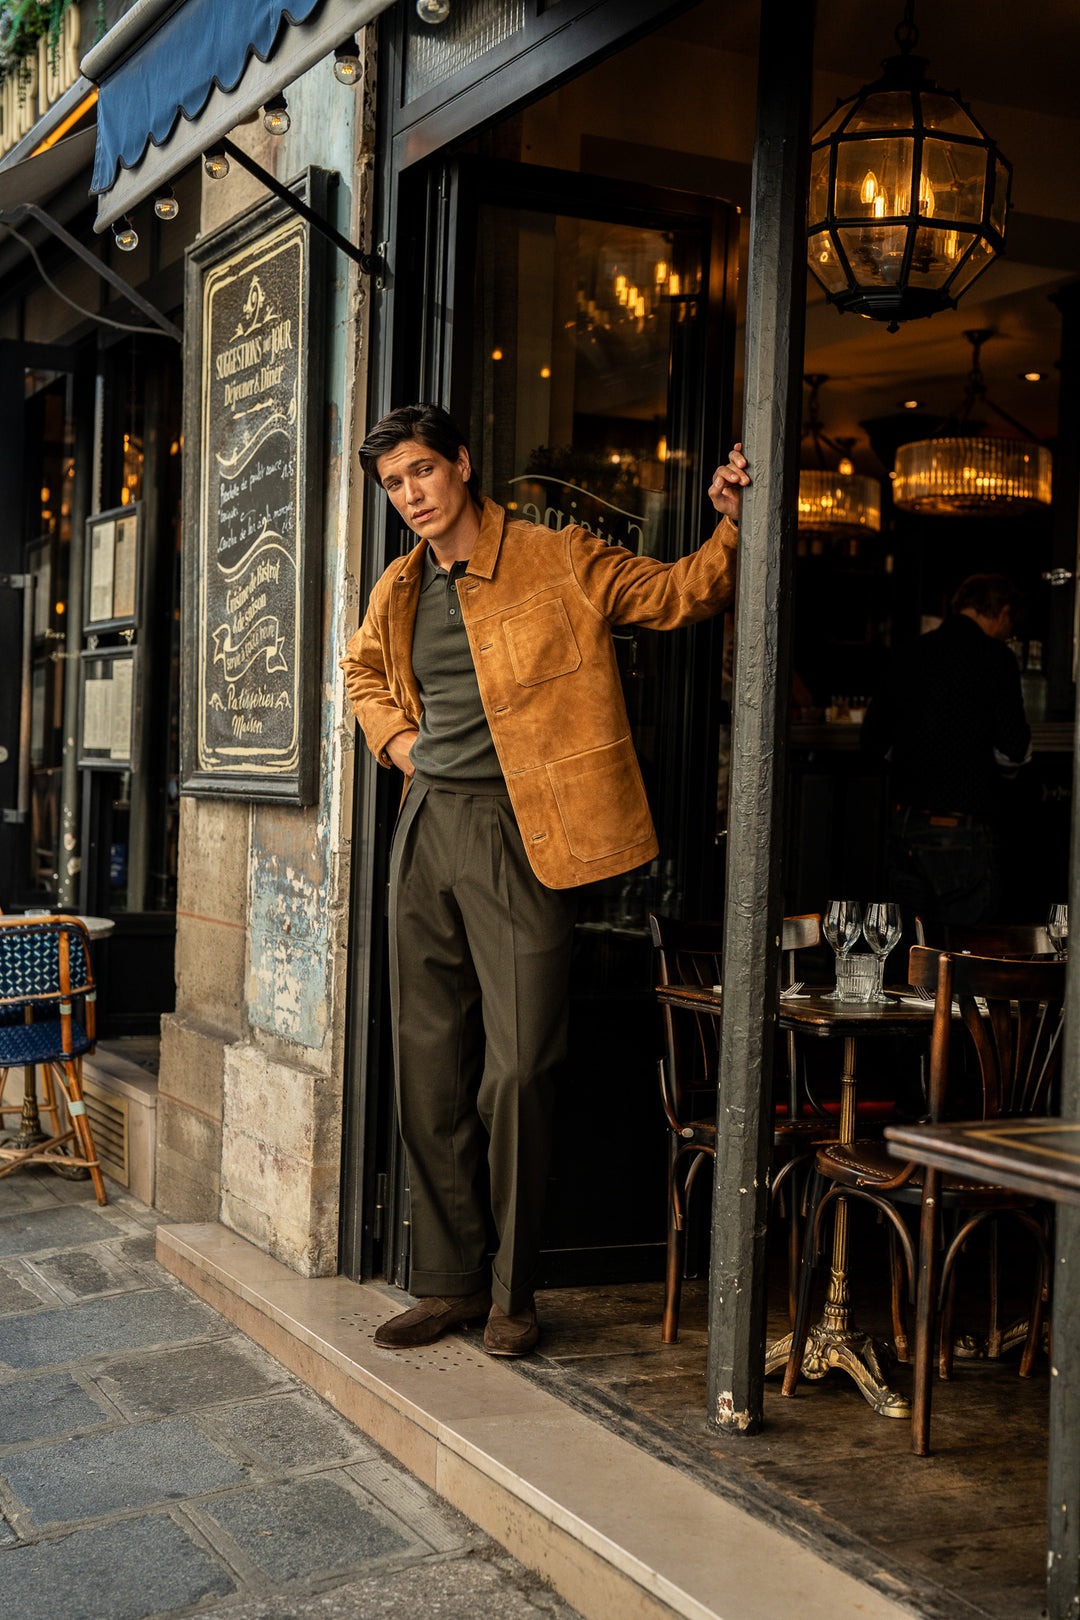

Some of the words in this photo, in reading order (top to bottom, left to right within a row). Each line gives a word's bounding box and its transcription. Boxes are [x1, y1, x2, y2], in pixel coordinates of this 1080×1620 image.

[216, 336, 262, 380] SUGGESTIONS
[269, 319, 293, 365] JOUR
[226, 586, 249, 615] Cuisine
[249, 572, 256, 593] de
[257, 558, 281, 586] Bistrot
[231, 714, 263, 740] Maison
